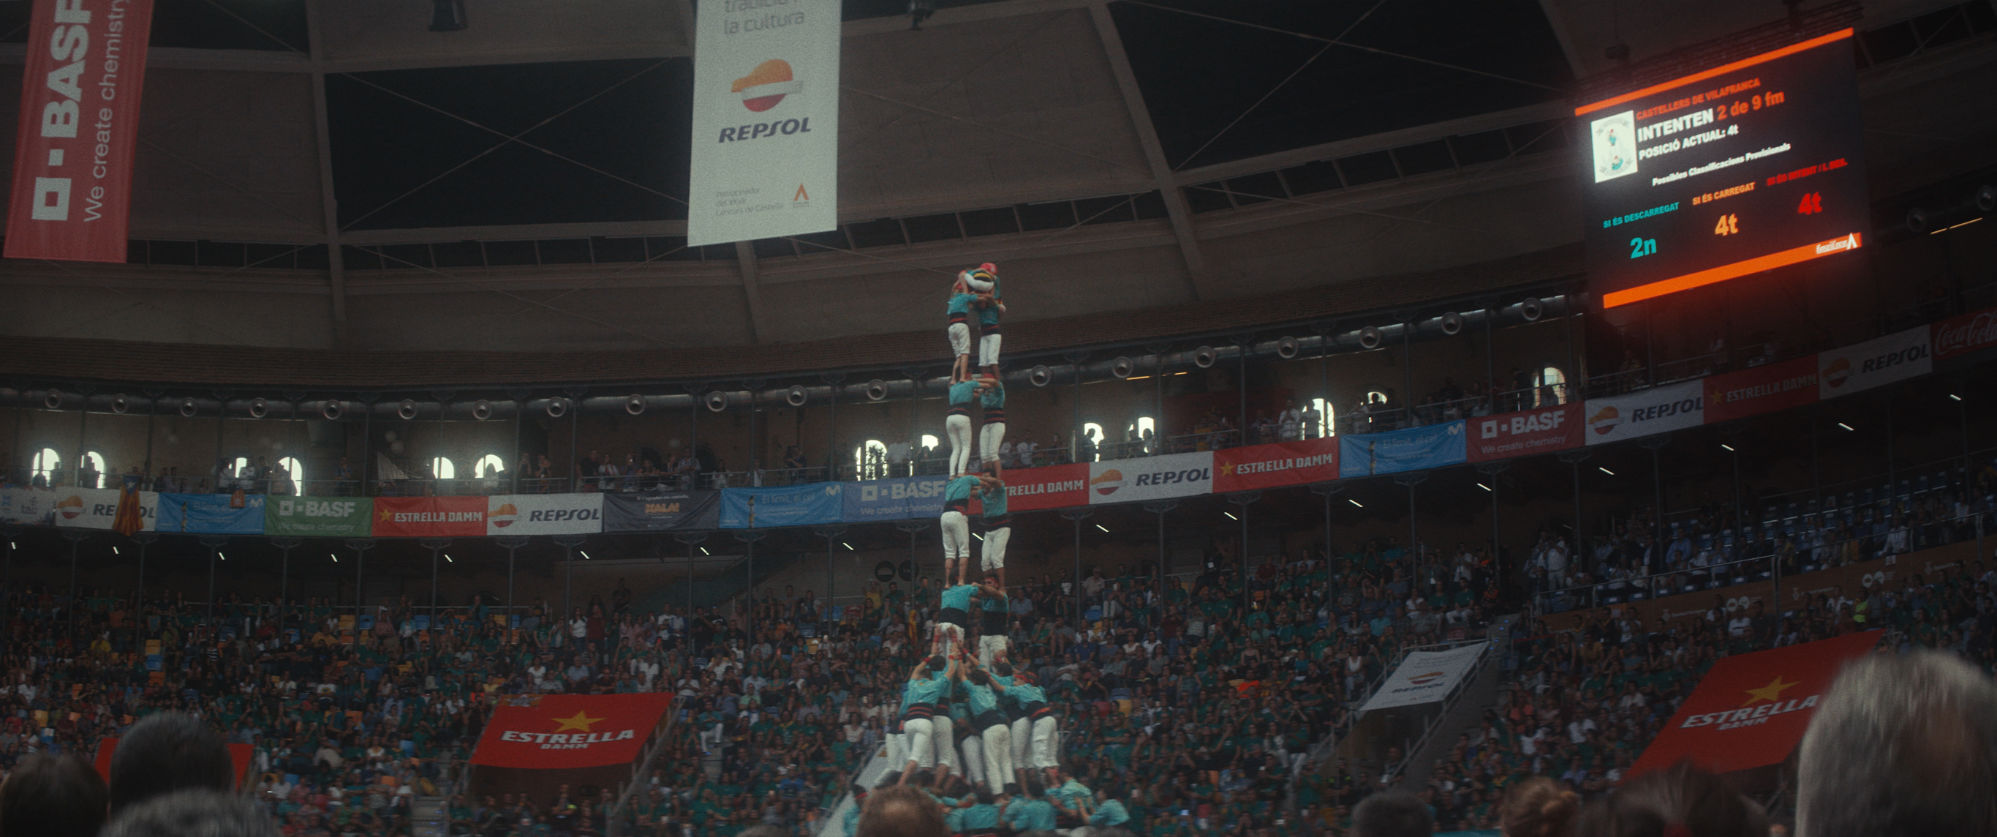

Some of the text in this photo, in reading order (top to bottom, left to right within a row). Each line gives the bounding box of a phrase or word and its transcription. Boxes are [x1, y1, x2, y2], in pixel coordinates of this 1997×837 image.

[724, 11, 805, 35] la cultura
[41, 0, 91, 138] BASF
[1636, 78, 1761, 120] CASTELLERS DE VILAFRANCA
[1637, 91, 1785, 143] INTENTEN 2 de 9 fm
[719, 117, 811, 143] REPSOL
[93, 107, 113, 178] create
[1638, 138, 1681, 161] POSICIÓ
[1682, 128, 1726, 150] ACTUAL:
[83, 186, 105, 222] We
[1692, 181, 1756, 206] SI ÉS CARREGAT
[1798, 191, 1823, 215] 4t
[1603, 202, 1680, 229] SI ÉS DESCARREGAT
[1714, 213, 1738, 236] 4t
[1630, 237, 1657, 259] 2n
[1862, 343, 1929, 373] REPSOL
[1726, 373, 1816, 402] ESTRELLA DAMM
[1632, 396, 1704, 423] REPSOL
[1511, 410, 1566, 436] BASF
[1481, 431, 1569, 455] We create chemistry
[1237, 453, 1333, 475] ESTRELLA DAMM
[1005, 480, 1084, 497] TRELLA DAMM
[1136, 468, 1210, 487] REPSOL
[891, 480, 946, 500] BASF
[93, 503, 155, 518] REOL
[305, 501, 356, 518] BASF
[394, 511, 483, 522] ESTRELLA DAMM
[530, 508, 600, 522] REPSOL
[1680, 694, 1820, 728] ESTRELLA
[1716, 716, 1769, 731] DAMM
[501, 729, 635, 744] ESTRELLA
